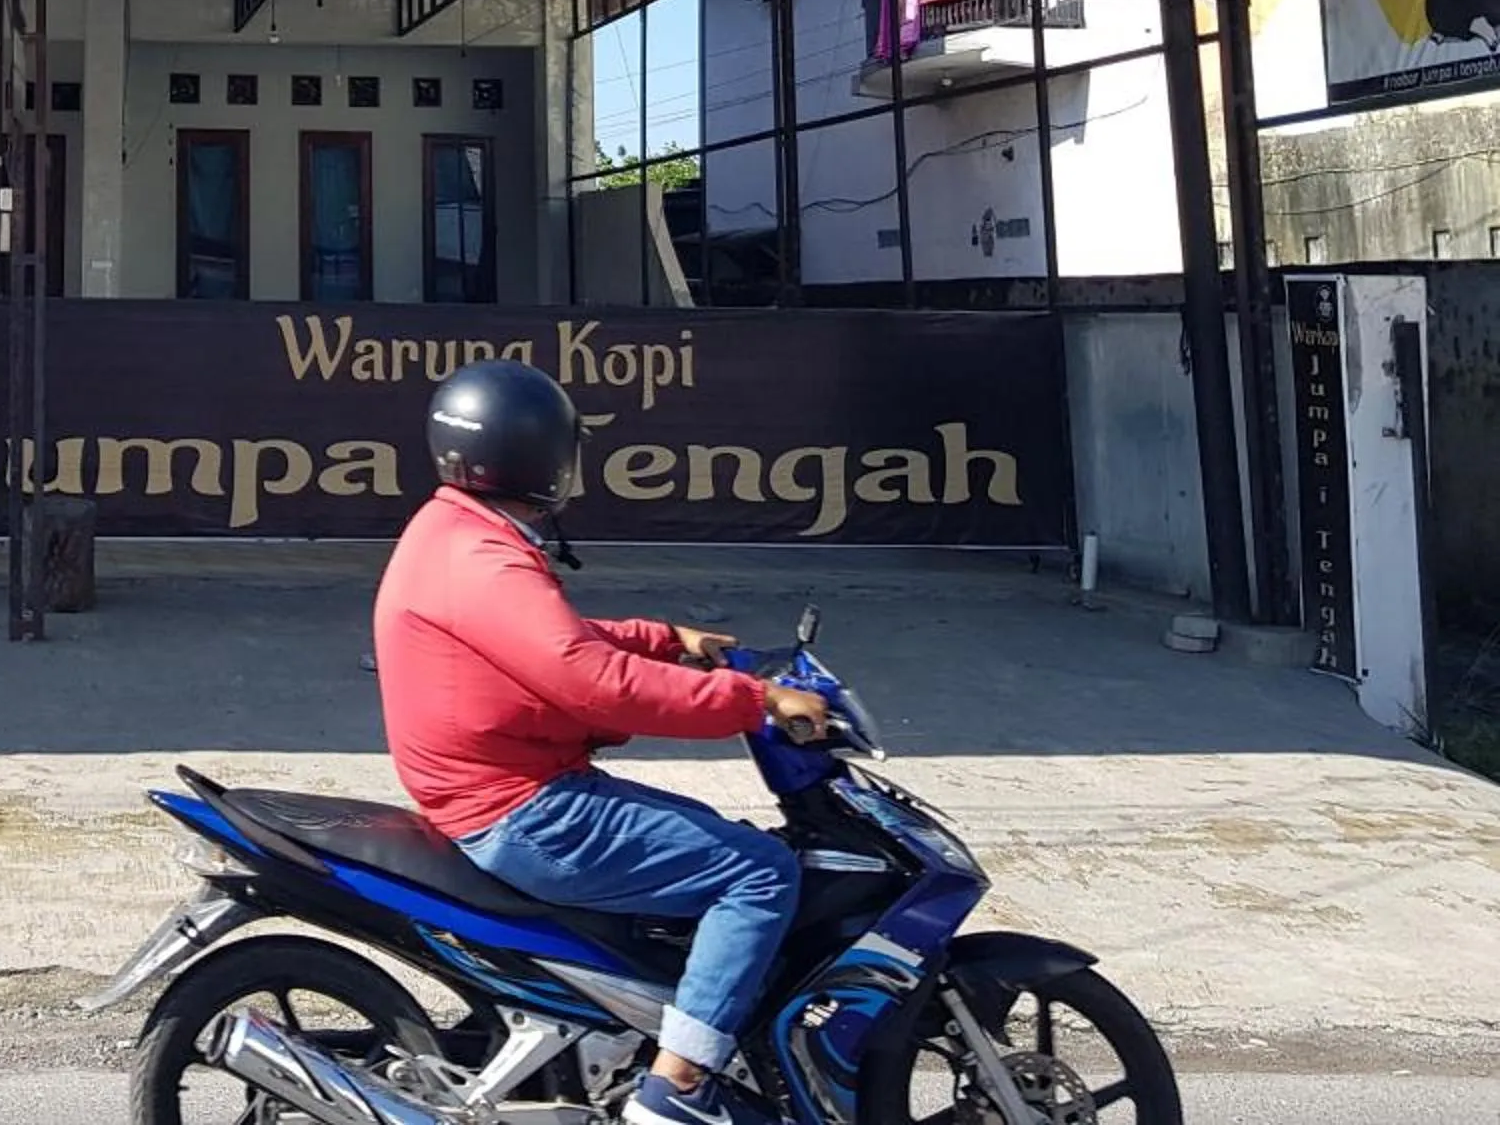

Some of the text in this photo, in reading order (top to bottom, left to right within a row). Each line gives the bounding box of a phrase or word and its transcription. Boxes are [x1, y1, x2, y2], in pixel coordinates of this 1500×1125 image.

[557, 320, 694, 410] Kopi
[1308, 354, 1329, 466] Jumpa
[1316, 530, 1338, 668] Tengah
